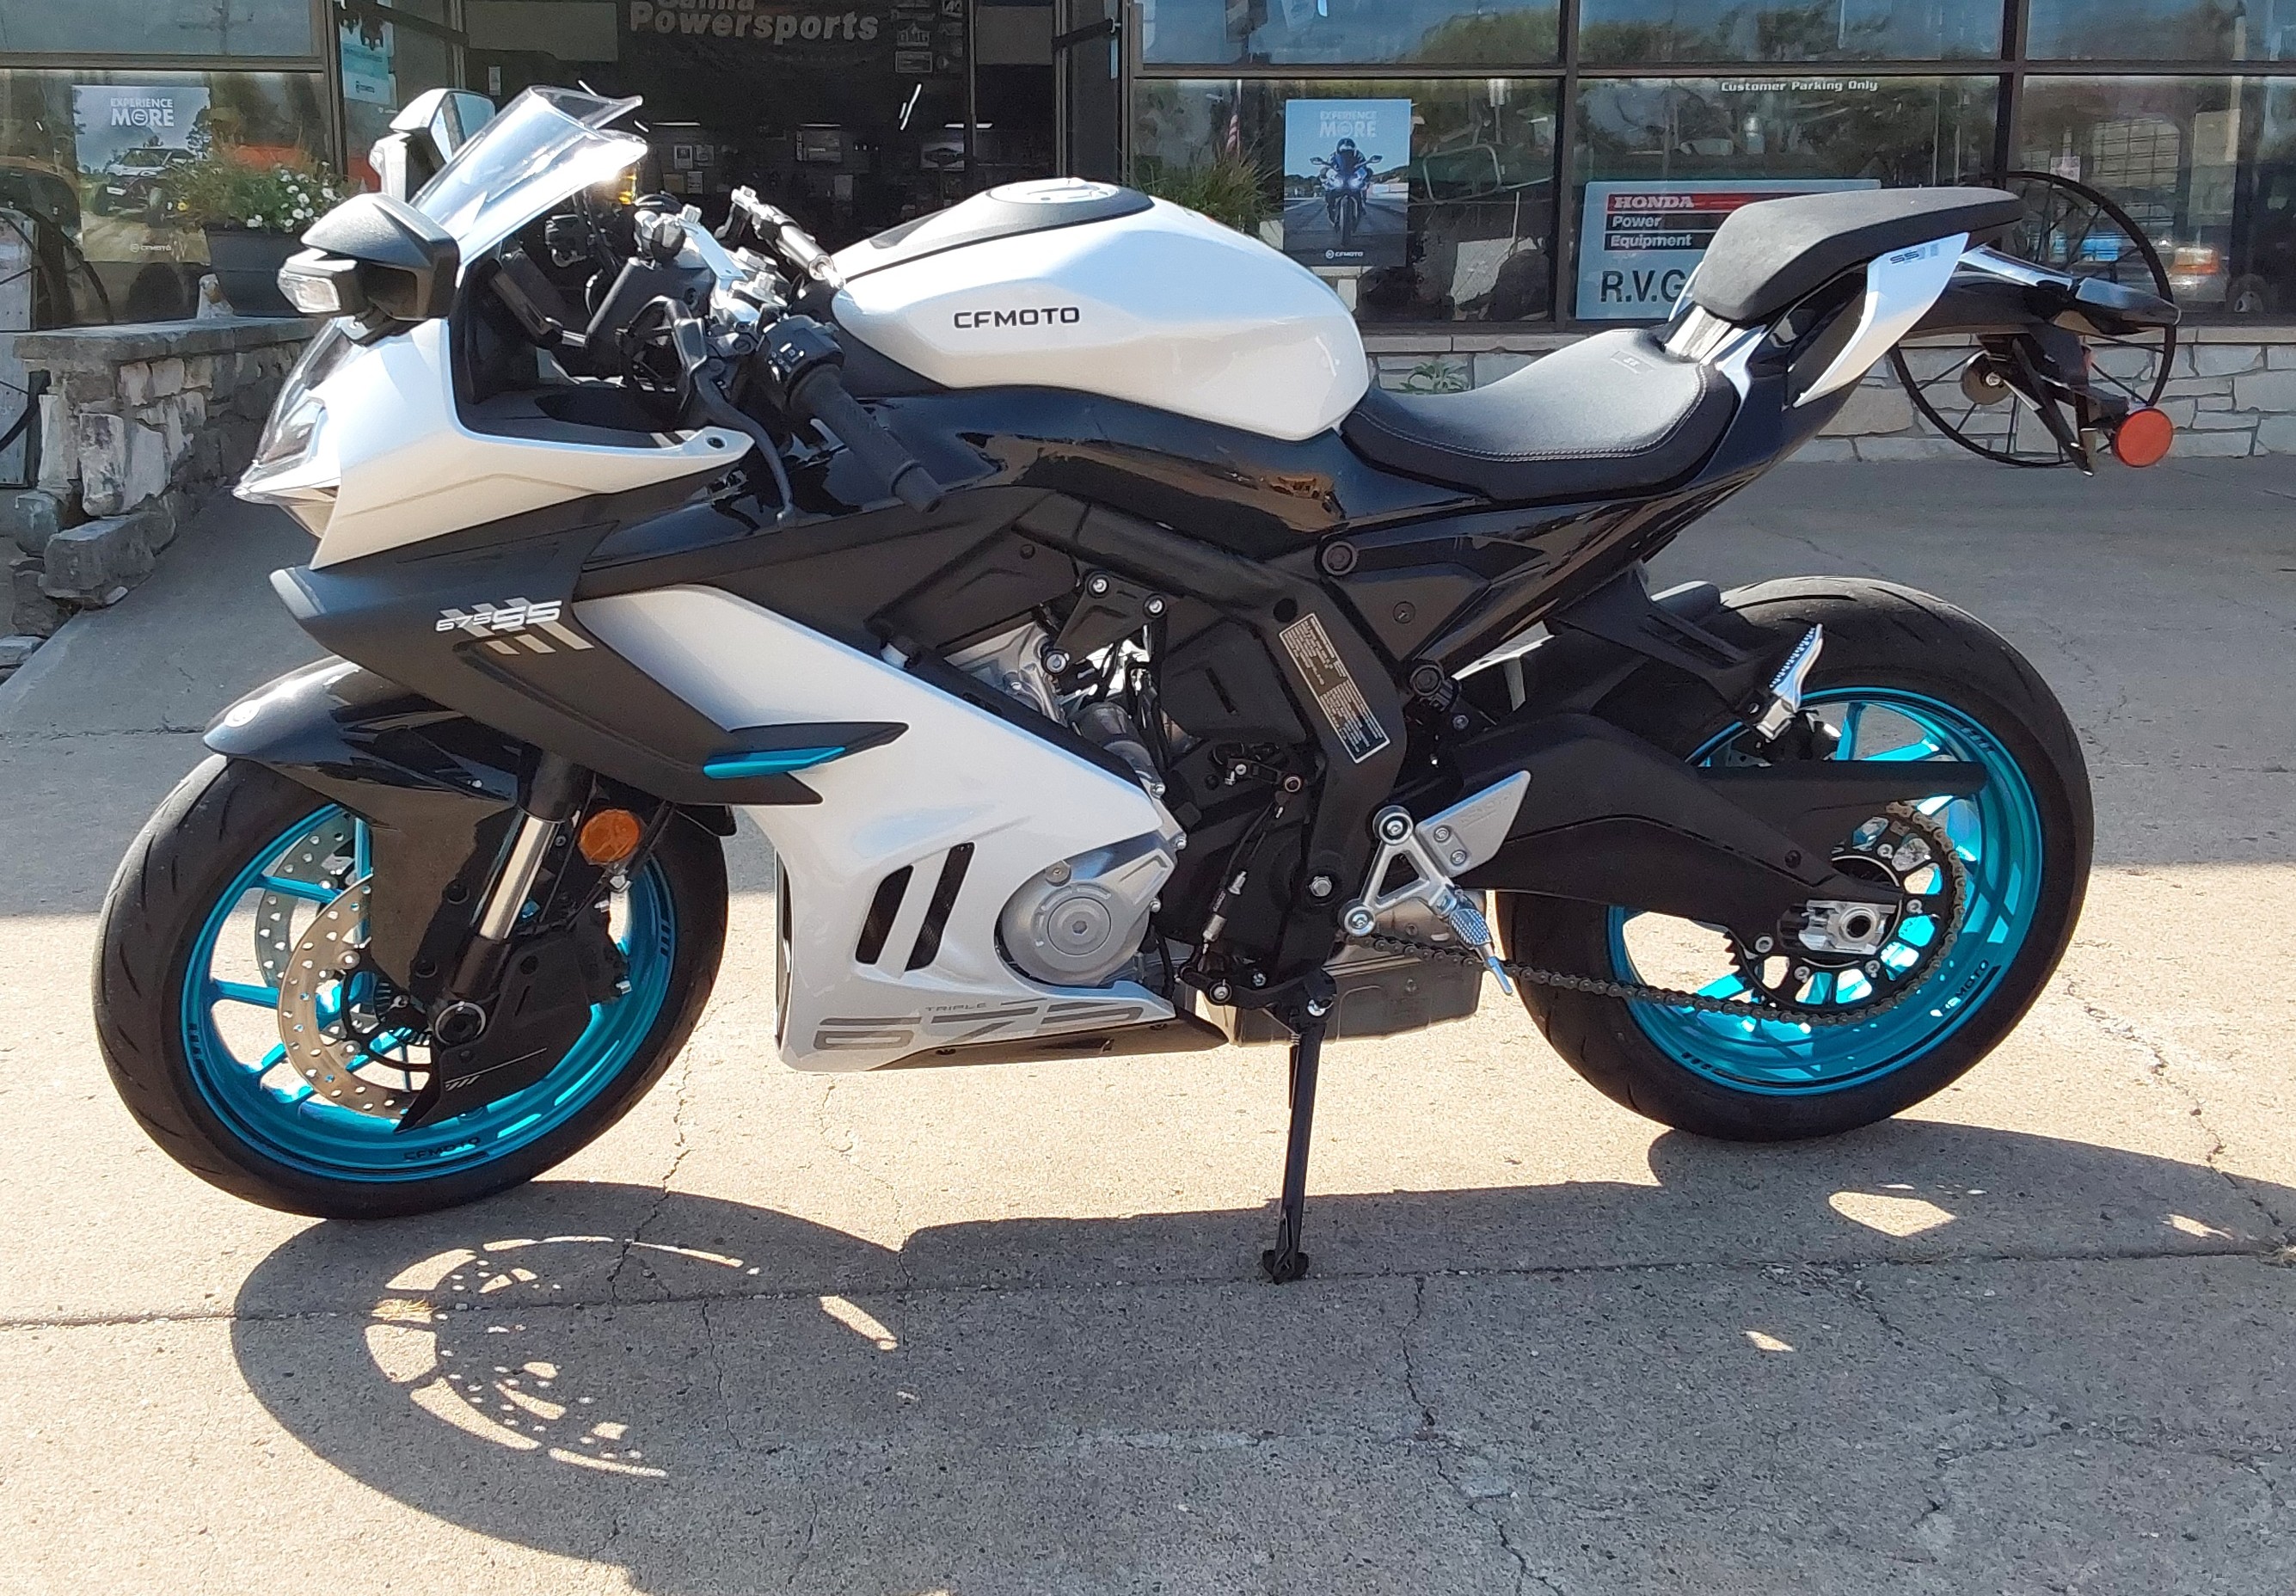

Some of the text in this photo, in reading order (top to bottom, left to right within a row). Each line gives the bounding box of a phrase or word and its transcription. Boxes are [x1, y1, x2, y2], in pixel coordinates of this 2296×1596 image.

[630, 2, 879, 45] Powersports
[1722, 80, 1878, 92] Customer Parking Only
[111, 98, 173, 108] EXPERIENCE
[111, 109, 175, 127] MORE
[1320, 111, 1378, 120] EXPERIENCE
[1320, 120, 1377, 138] MORE
[1614, 196, 1694, 208] HONDA
[1612, 216, 1662, 228] Power
[1611, 234, 1692, 249] Equipment
[954, 307, 1080, 328] CFMOTO
[925, 1002, 987, 1011] TRIPLE
